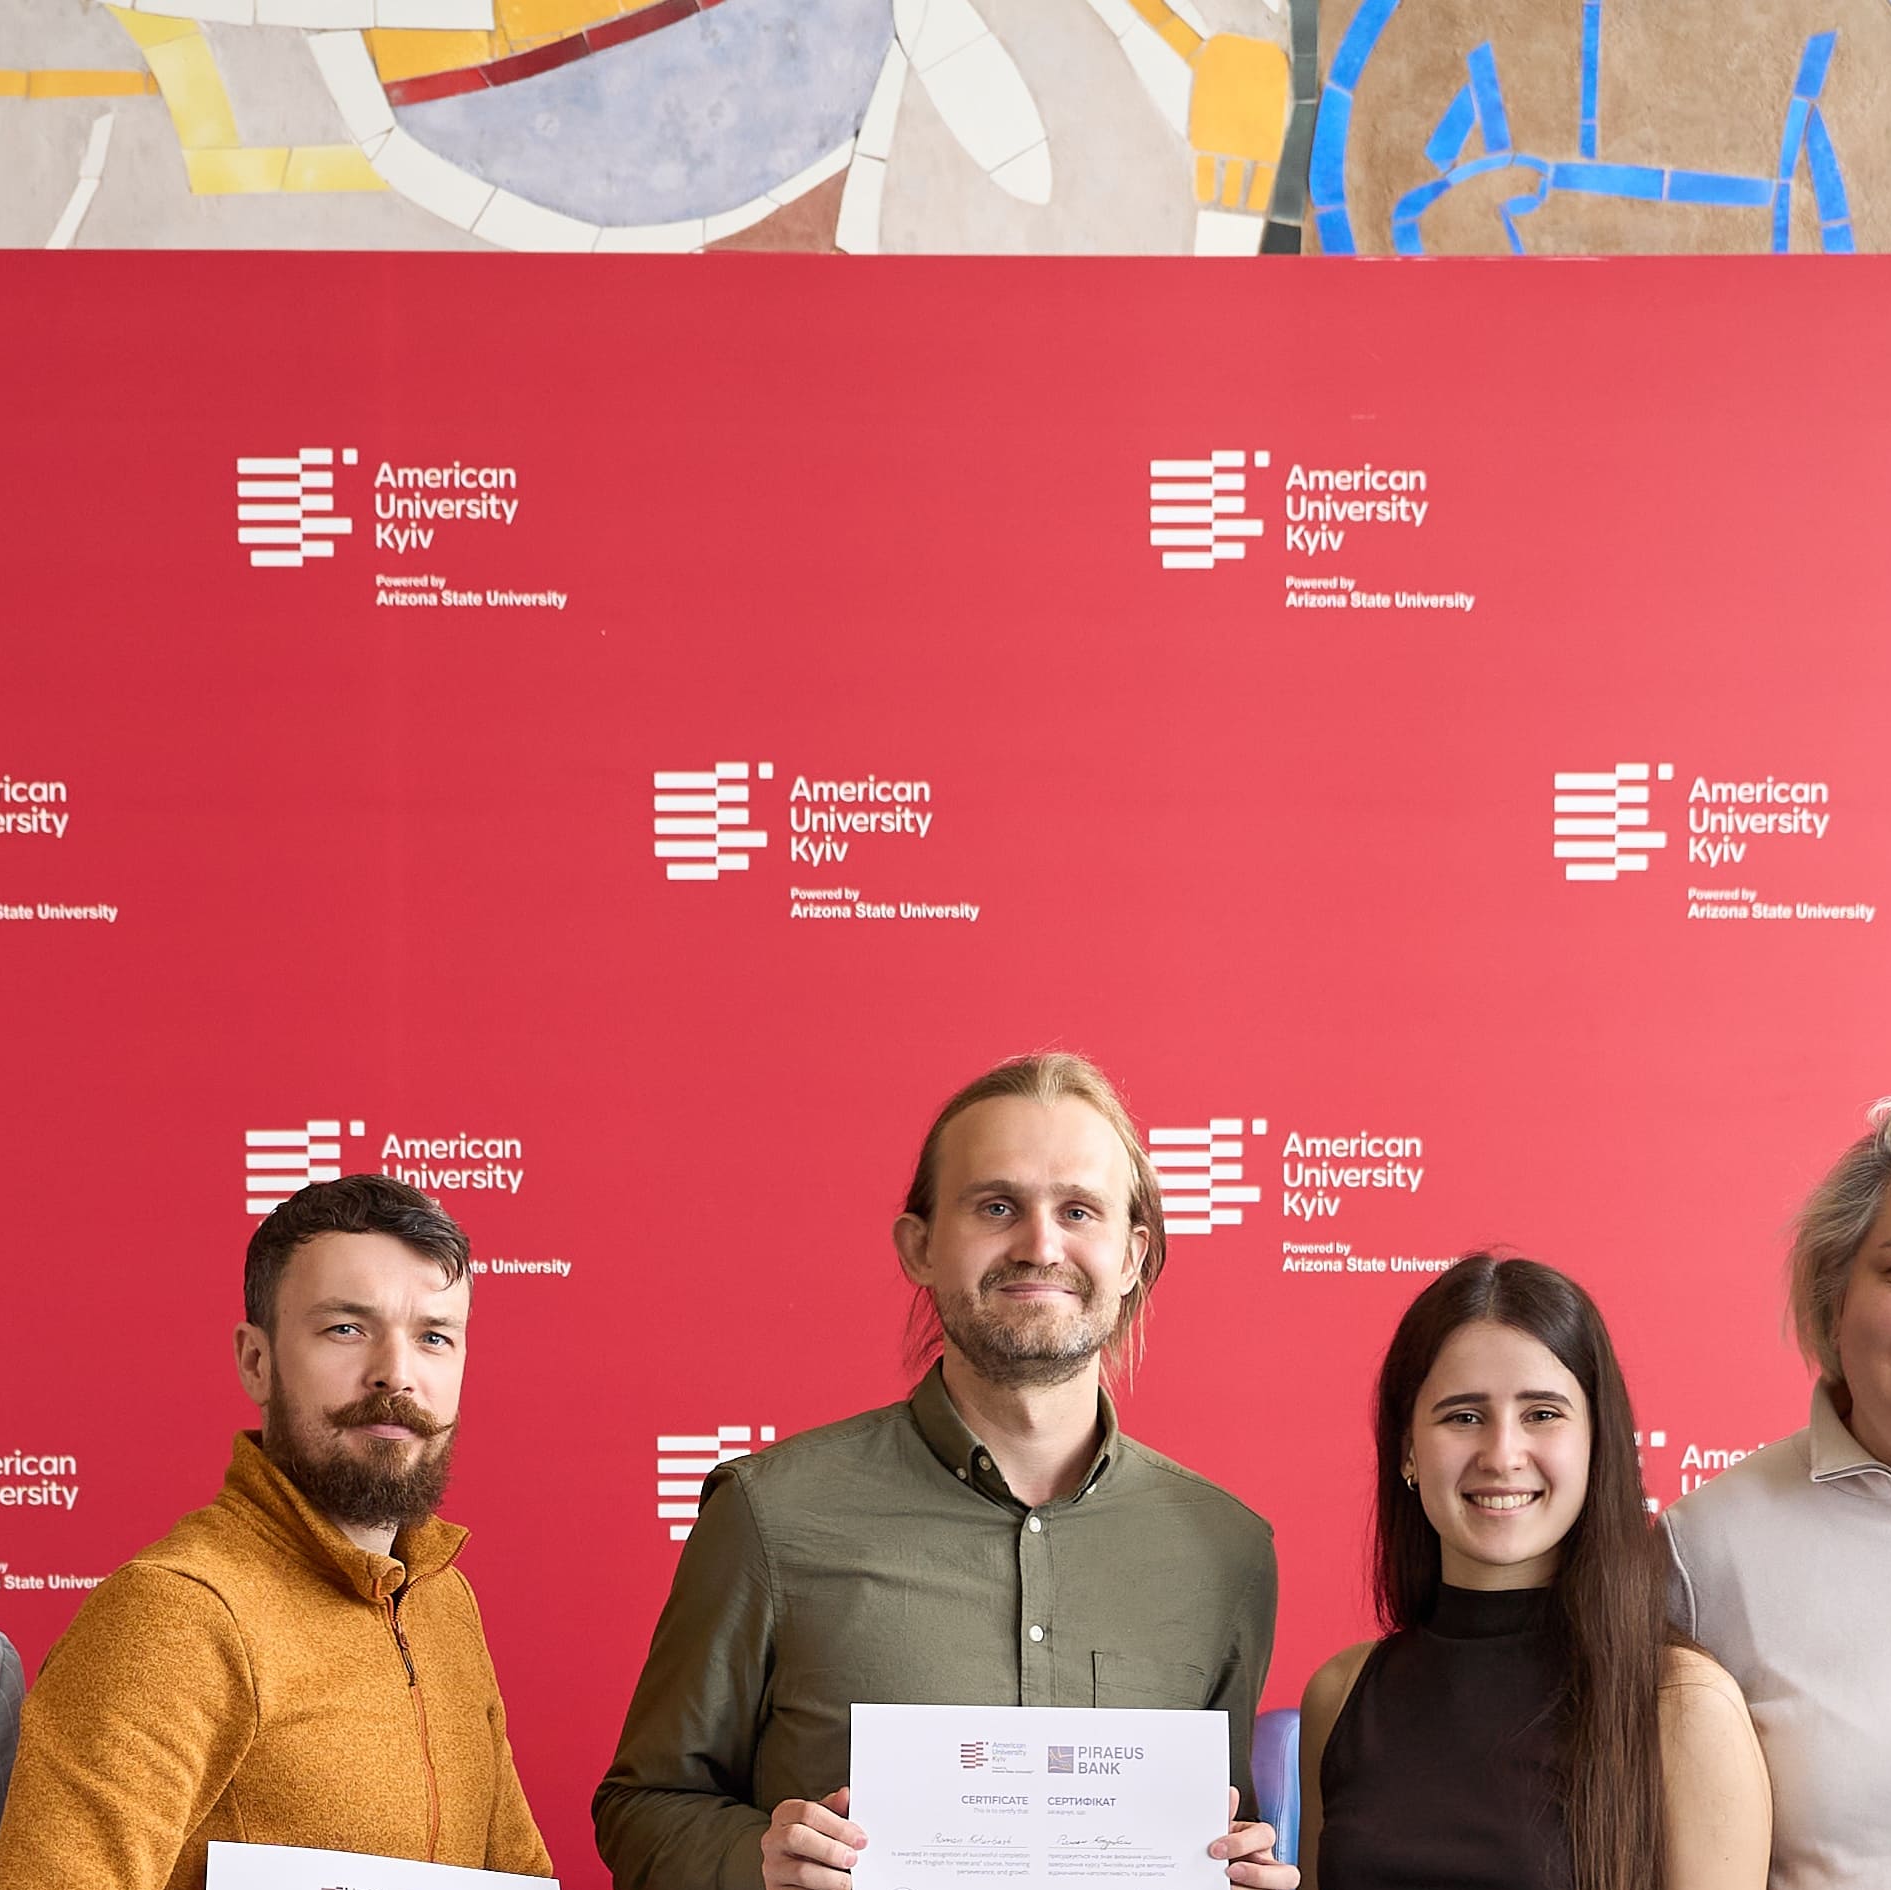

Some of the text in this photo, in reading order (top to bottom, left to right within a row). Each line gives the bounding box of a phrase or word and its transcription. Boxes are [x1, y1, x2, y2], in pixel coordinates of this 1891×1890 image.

[375, 461, 516, 488] American
[1286, 464, 1426, 491] American
[376, 492, 518, 523] University
[1287, 494, 1428, 525] University
[376, 522, 433, 553] Kyiv
[1287, 524, 1344, 555] Kyiv
[376, 575, 445, 589] Powered by
[1286, 576, 1355, 590] Powered by
[376, 590, 567, 609] Arizona State University
[1286, 591, 1474, 611] Arizona State University
[790, 775, 930, 802] American
[1689, 776, 1828, 803] American
[791, 805, 932, 836] University
[1690, 806, 1830, 837] University
[791, 835, 848, 866] Kyiv
[1690, 836, 1747, 867] Kyiv
[791, 888, 859, 901] Powered by
[1688, 888, 1756, 902] Powered by
[37, 904, 118, 922] University
[791, 902, 979, 921] Arizona State University
[1688, 903, 1875, 922] Arizona State University
[382, 1133, 521, 1159] American
[1283, 1131, 1421, 1157] American
[1284, 1161, 1423, 1192] University
[1284, 1190, 1341, 1221] Kyiv
[1283, 1242, 1350, 1256] Powered by
[492, 1259, 571, 1277] University
[1283, 1257, 1342, 1272] Arizona
[1347, 1257, 1386, 1272] State
[4, 1575, 44, 1589] State
[1078, 1746, 1144, 1760] PIRAEUS
[1078, 1762, 1121, 1775] BANK
[961, 1795, 1029, 1805] CERTIFICATE
[1048, 1797, 1116, 1807] СЕРТИФІКАТ
